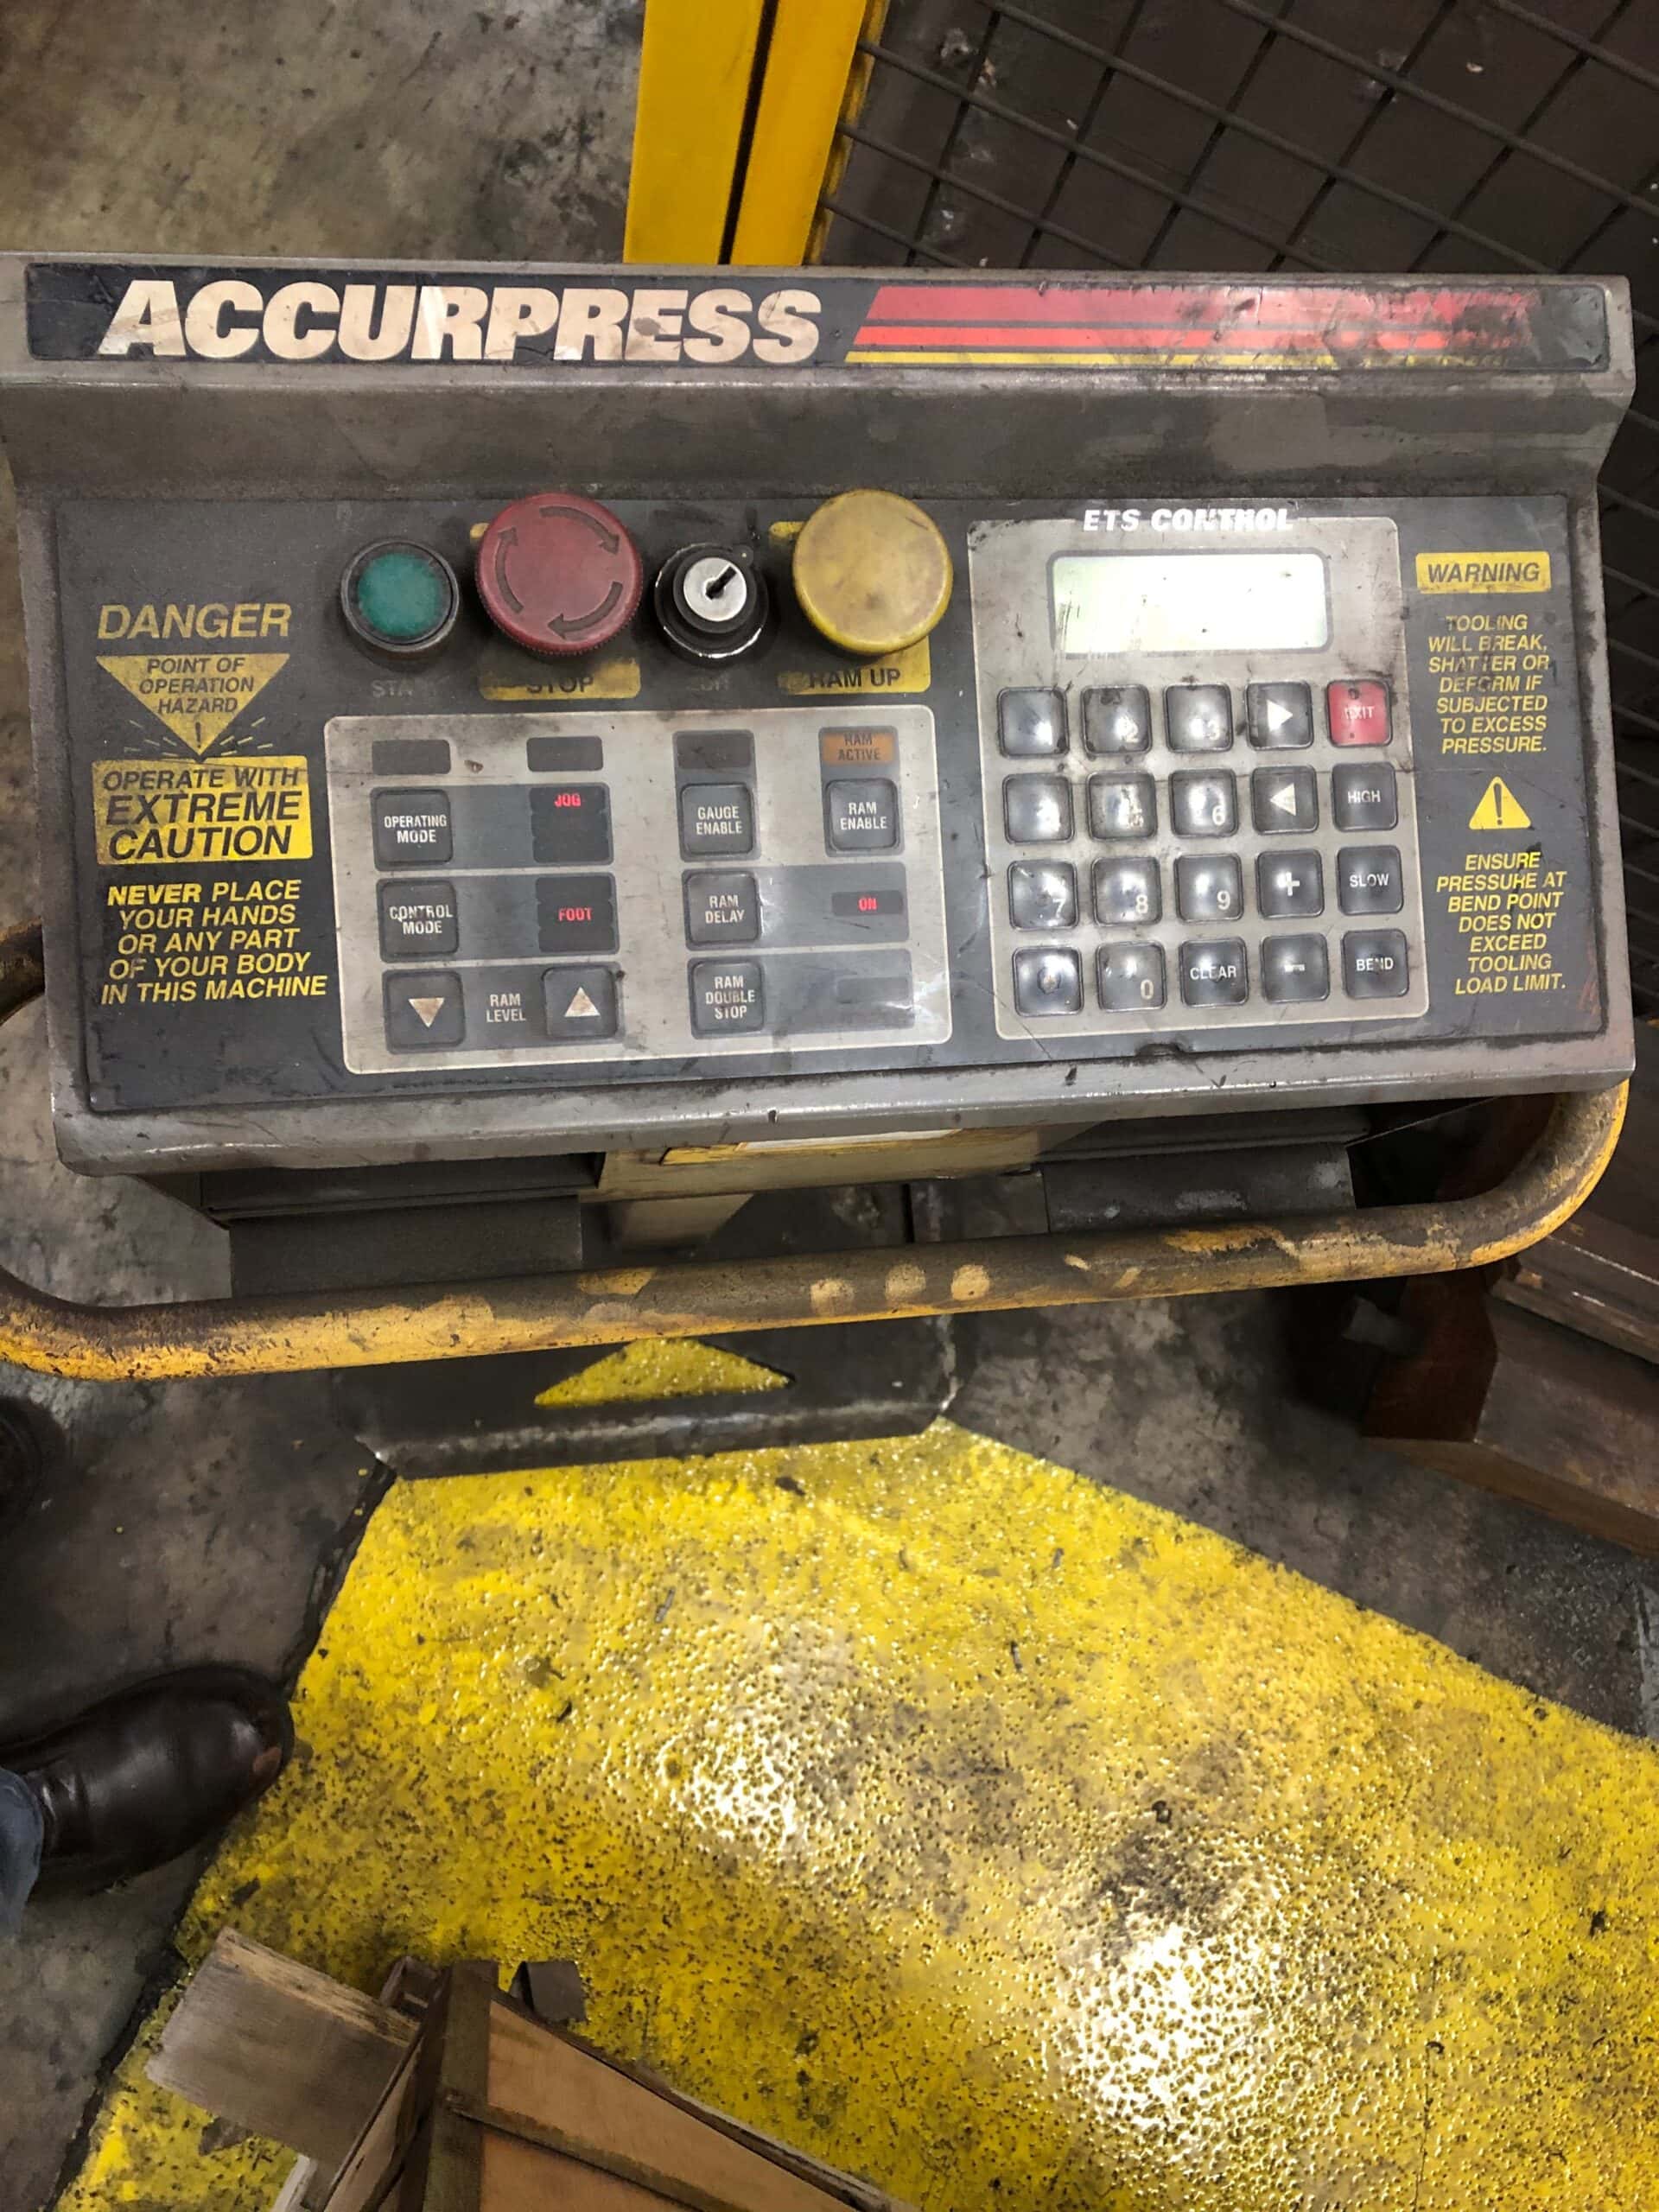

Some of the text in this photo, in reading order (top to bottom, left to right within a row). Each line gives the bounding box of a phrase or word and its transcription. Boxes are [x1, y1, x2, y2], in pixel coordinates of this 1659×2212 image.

[97, 279, 822, 364] ACCURPRESS
[1084, 508, 1294, 532] ETS CONTROL
[1427, 563, 1539, 582] WARNING
[97, 603, 291, 639] DANGER
[1446, 614, 1528, 632] TOOLING
[1428, 634, 1548, 652] WILL BREAK,
[147, 657, 245, 673] POINT OF
[1522, 655, 1549, 671] OR
[139, 677, 254, 695] OPERATION
[527, 675, 594, 694] STOP
[809, 668, 900, 689] RAM UP
[1440, 675, 1543, 693] DEFORM IF
[158, 697, 238, 714] HAZARD
[1344, 706, 1375, 720] EXIT
[1437, 695, 1548, 714] SUBJECTED
[1440, 715, 1547, 734] TO EXCESS
[1442, 736, 1547, 754] PRESSURE.
[837, 748, 880, 761] ACTIVE
[103, 767, 299, 791] OPERATE WITH
[554, 794, 581, 807] JOG
[1348, 791, 1381, 804] HIGH
[106, 791, 302, 825] EXTREME
[698, 806, 739, 820] GAUGE
[849, 802, 876, 814] RAM
[1212, 805, 1225, 825] 6
[385, 815, 447, 828] OPERATING
[696, 822, 742, 835] ENABLE
[840, 817, 887, 830] ENABLE
[109, 825, 292, 860] CAUTION
[397, 830, 436, 843] MODE
[1465, 852, 1541, 871] ENSURE
[1350, 874, 1389, 887] SLOW
[1436, 871, 1567, 893] PRESSURE AT
[107, 879, 302, 906] NEVER PLACE
[709, 895, 738, 907] RAM
[1217, 890, 1230, 910] 9
[859, 898, 877, 911] ON
[1135, 894, 1148, 913] 8
[1448, 892, 1564, 912] BEND POINT
[119, 904, 296, 931] YOUR HANDS
[390, 906, 453, 920] CONTROL
[558, 907, 593, 921] FOOT
[705, 910, 745, 924] DELAY
[1459, 912, 1556, 932] DOES NOT
[402, 920, 442, 935] MODE
[118, 928, 300, 955] OR ANY PART
[1470, 933, 1547, 952] EXCEED
[109, 951, 311, 980] OF YOUR BODY
[1357, 957, 1394, 971] BEND
[1468, 954, 1552, 973] TOOLING
[715, 976, 743, 988] RAM
[1190, 965, 1236, 981] CLEAR
[101, 975, 327, 1005] IN THIS MACHINE
[1455, 973, 1567, 995] LOAD LIMIT.
[490, 994, 520, 1007] RAM
[706, 990, 755, 1004] DOUBLE
[486, 1008, 525, 1022] LEVEL
[715, 1005, 747, 1019] STOP
